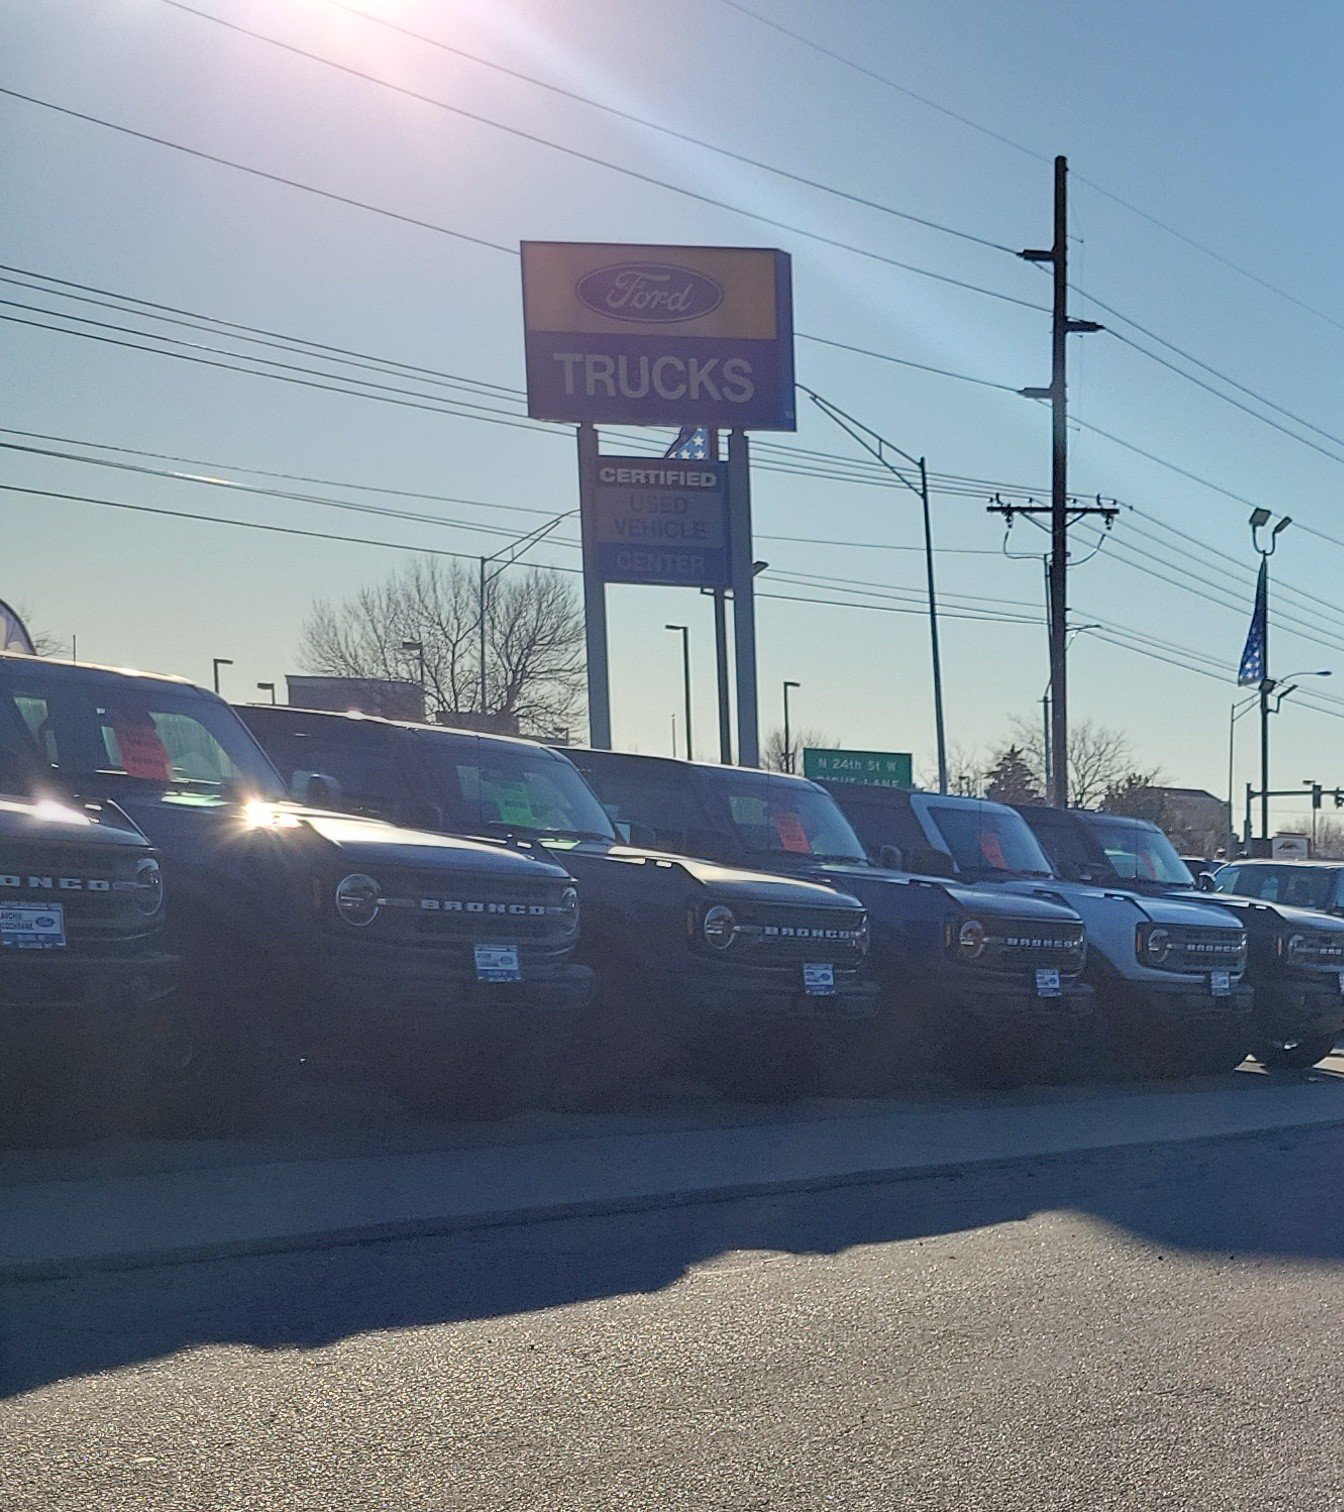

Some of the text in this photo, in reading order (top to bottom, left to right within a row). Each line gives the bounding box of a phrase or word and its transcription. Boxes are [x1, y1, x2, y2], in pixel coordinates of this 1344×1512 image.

[606, 270, 694, 313] Ford
[552, 352, 755, 404] TRUCKS
[600, 467, 718, 487] CERTIFIED
[629, 494, 689, 515] USED
[613, 517, 707, 540] VEHICLE
[616, 550, 706, 575] CENTER
[832, 758, 862, 770] 24th
[867, 760, 880, 771] St
[886, 761, 897, 773] W
[0, 873, 109, 891] ONCO
[421, 899, 545, 915] BRONCO
[764, 925, 851, 939] BRONCO
